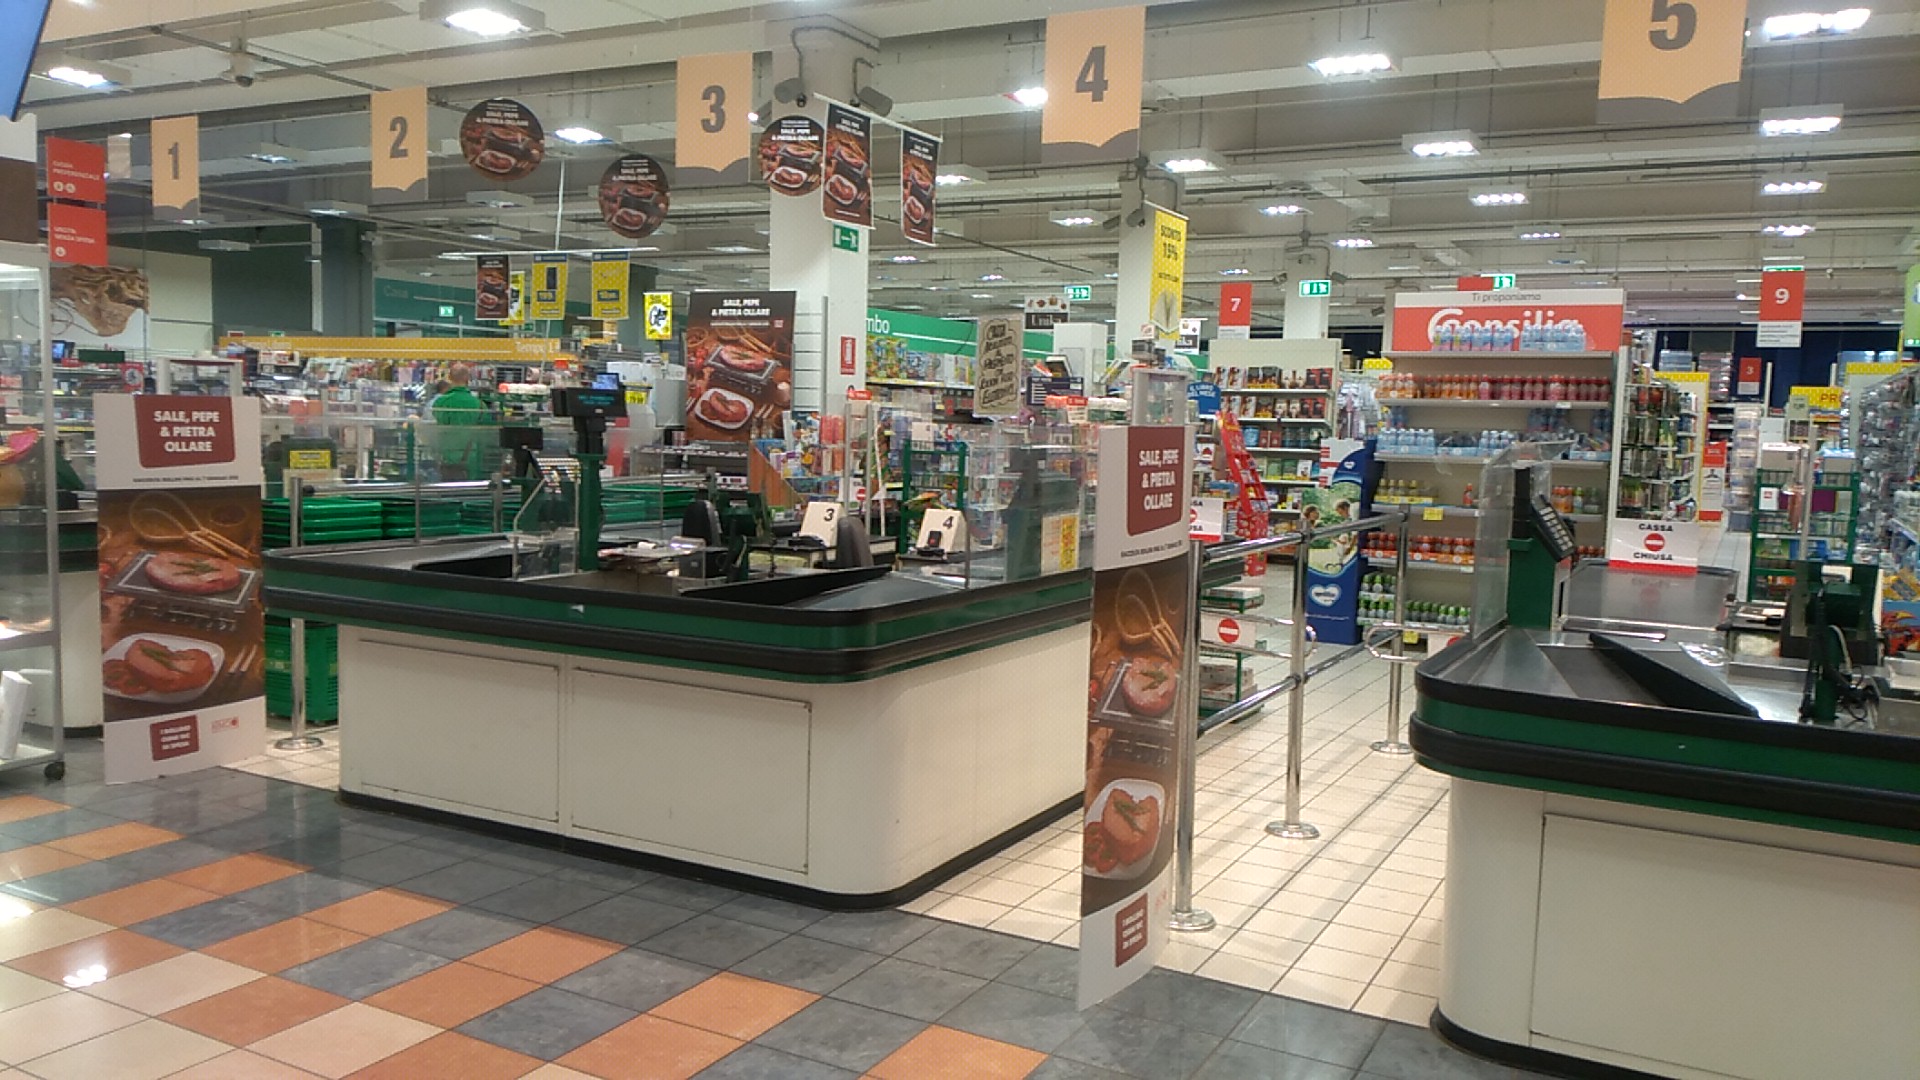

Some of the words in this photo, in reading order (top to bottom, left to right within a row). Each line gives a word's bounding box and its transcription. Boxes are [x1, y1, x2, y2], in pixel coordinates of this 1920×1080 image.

[1648, 0, 1698, 50] 5
[1076, 46, 1109, 103] 4
[701, 84, 726, 133] 3
[389, 116, 409, 159] 2
[168, 142, 179, 180] 1
[1482, 292, 1542, 303] proponiamo
[1775, 288, 1790, 305] 9
[1230, 298, 1241, 312] 7
[1746, 366, 1754, 375] 3
[154, 411, 190, 424] SALE,
[191, 411, 220, 422] PEPE
[159, 427, 170, 437] &
[172, 426, 216, 437] PIETRA
[164, 442, 213, 452] OLLARE
[1139, 450, 1162, 467] SALE,
[1162, 448, 1180, 465] PEPE
[1142, 472, 1149, 488] &
[1150, 470, 1176, 487] PIETRA
[1144, 492, 1173, 511] OLLARE
[824, 508, 834, 522] 3
[942, 515, 954, 530] 4
[1638, 523, 1674, 532] CASSA
[1633, 551, 1674, 561] CHIUSA
